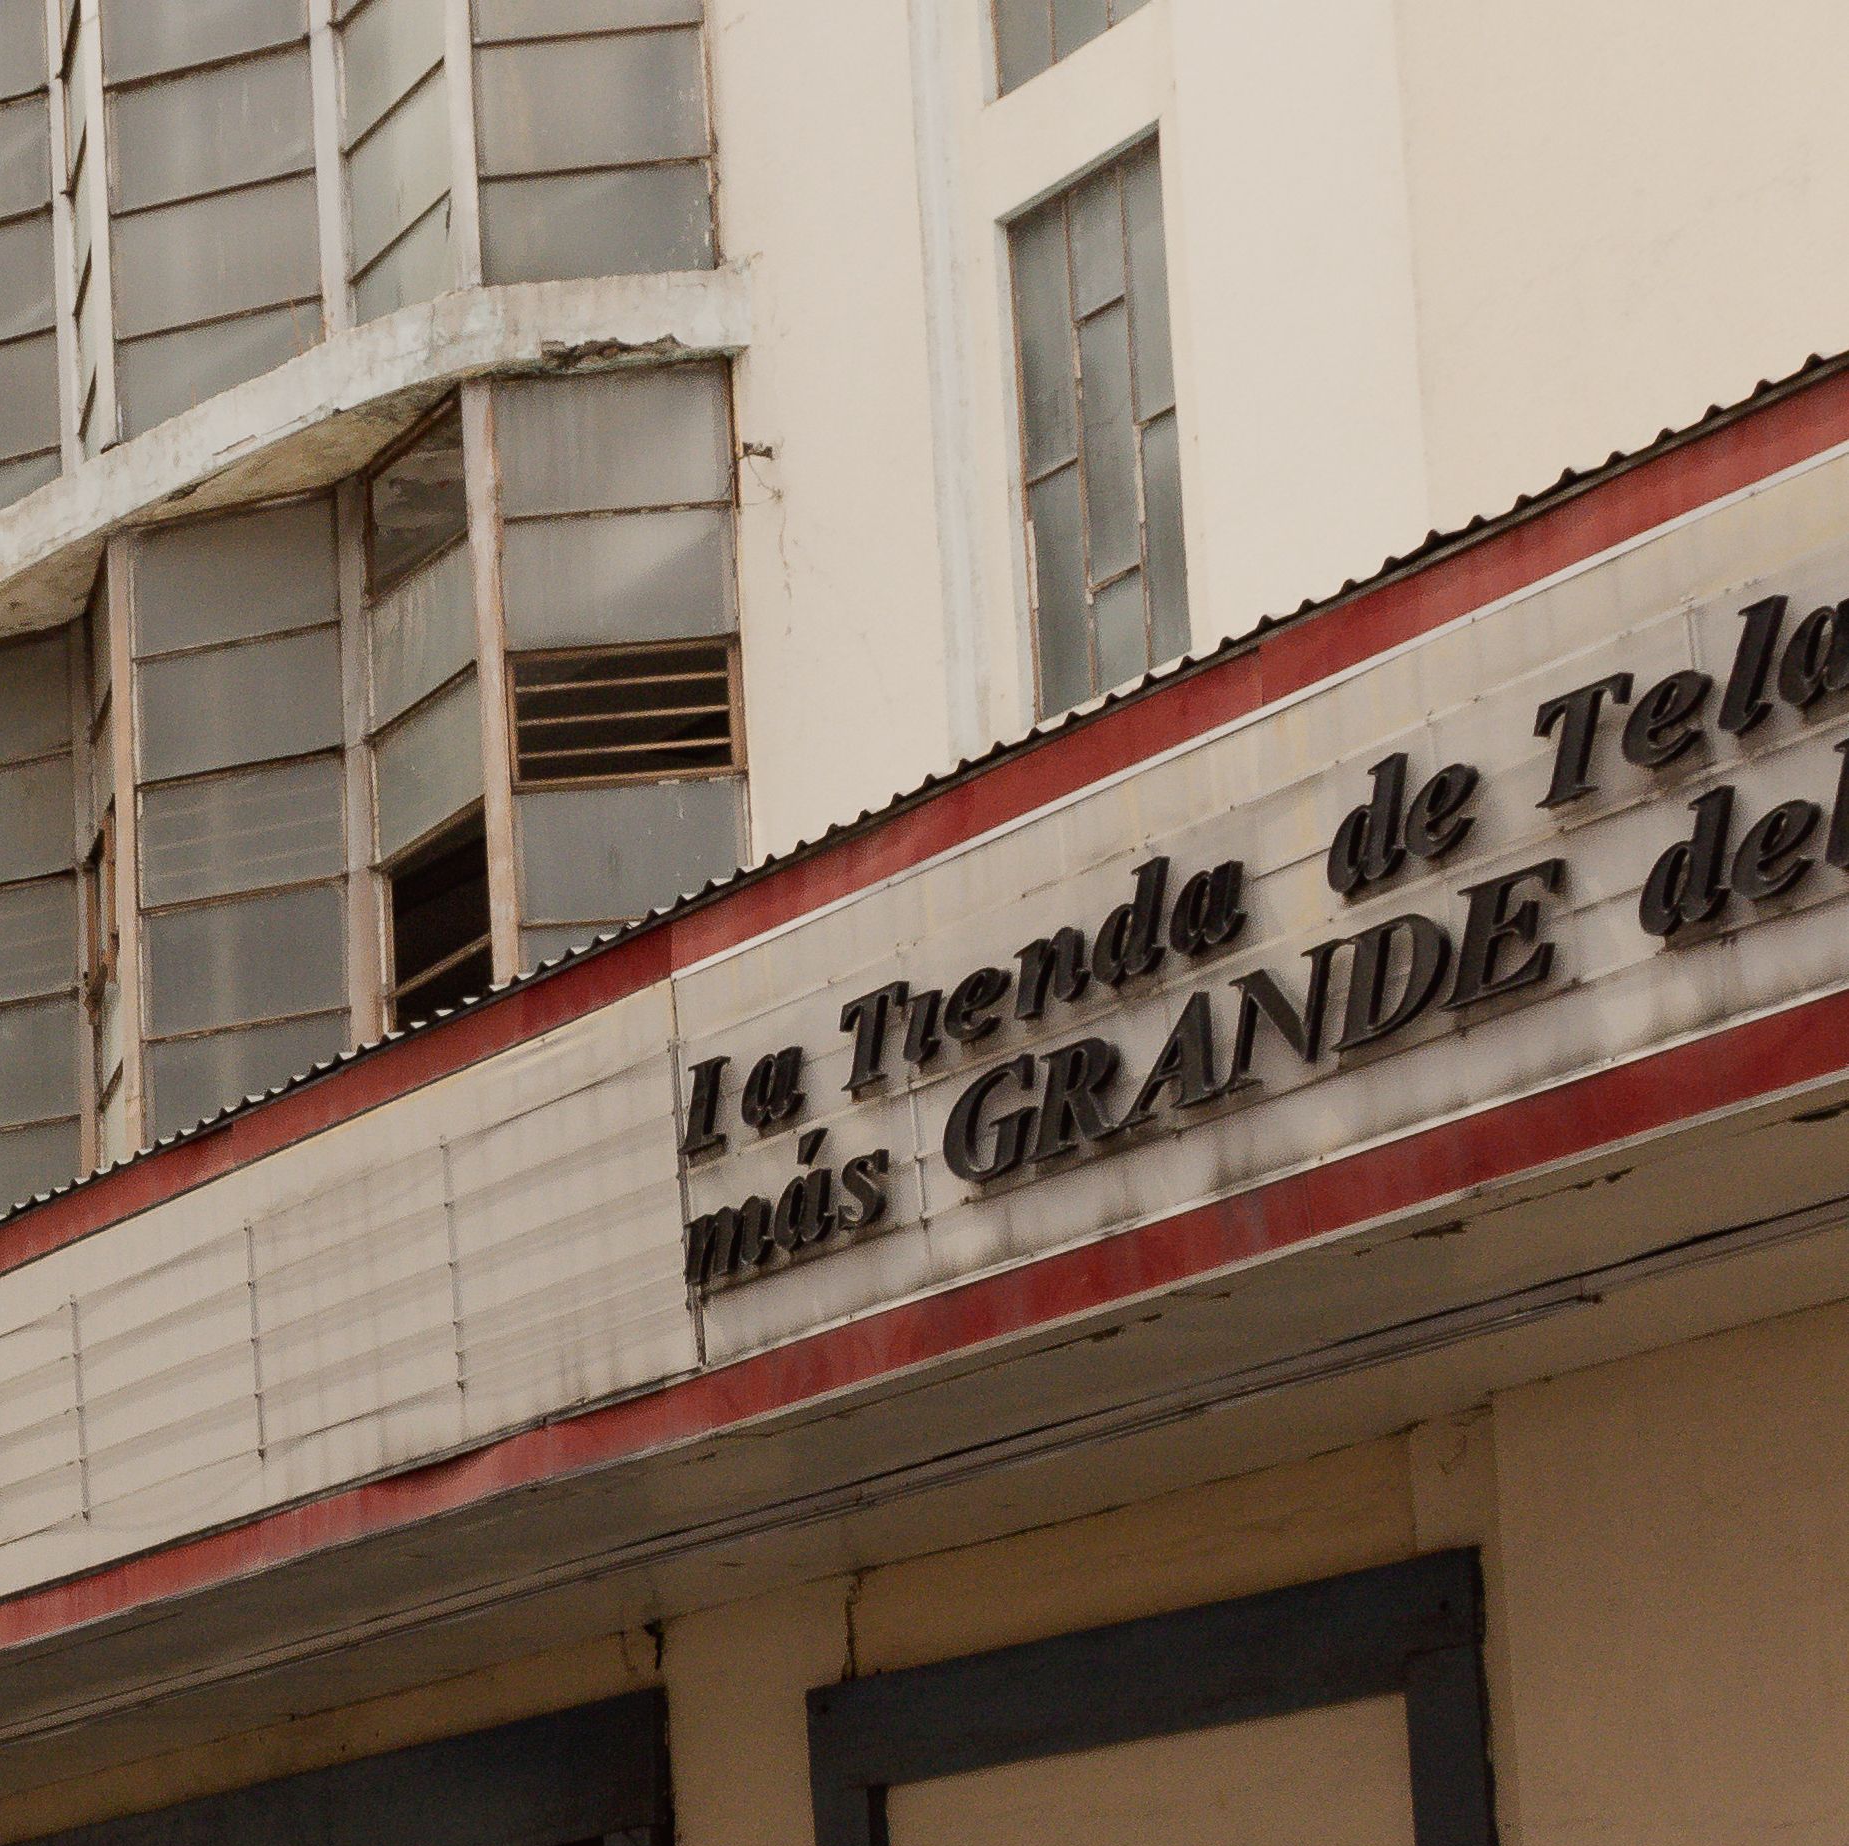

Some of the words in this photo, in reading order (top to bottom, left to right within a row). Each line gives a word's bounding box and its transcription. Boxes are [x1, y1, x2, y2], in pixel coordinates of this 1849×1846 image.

[685, 1127, 889, 1284] más
[942, 857, 1567, 1183] GRANDE
[839, 855, 1248, 1091] Tienda
[1325, 752, 1482, 896] de
